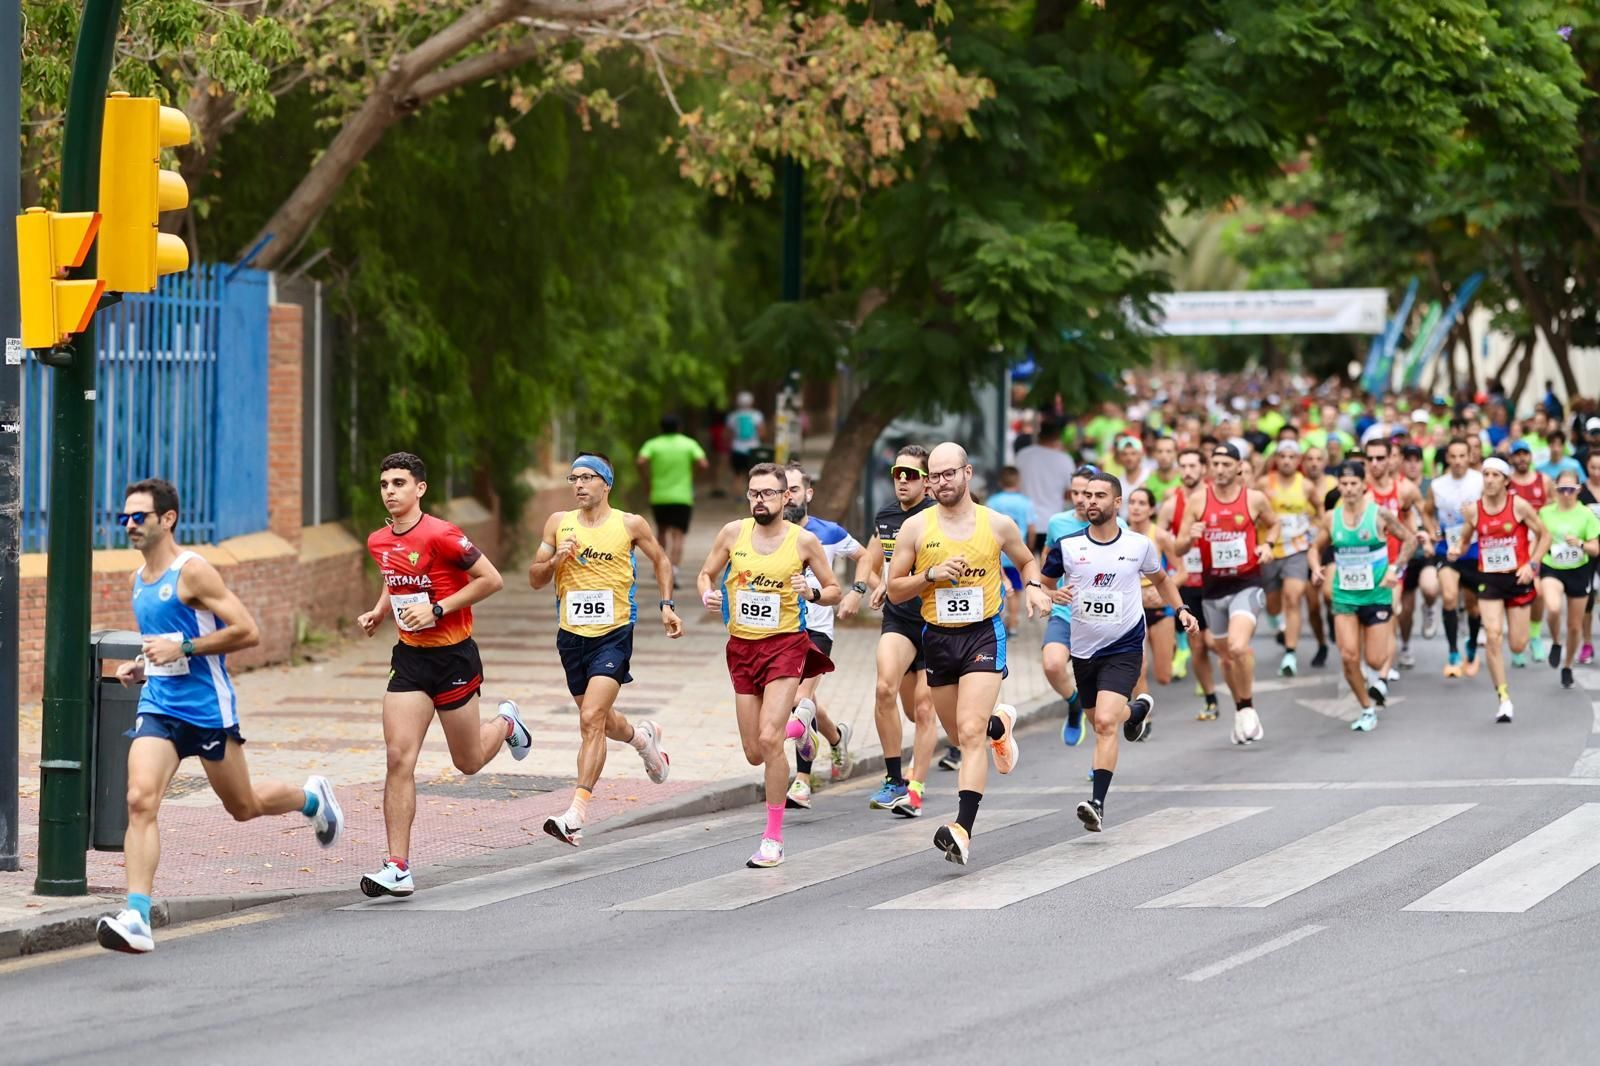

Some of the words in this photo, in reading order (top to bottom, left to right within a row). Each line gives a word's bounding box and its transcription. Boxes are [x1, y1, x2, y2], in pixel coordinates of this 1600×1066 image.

[580, 545, 614, 561] Álora
[1216, 549, 1241, 560] 732
[384, 574, 432, 587] ARTAMA
[752, 573, 784, 588] Álora
[572, 602, 605, 615] 796
[741, 603, 772, 618] 692
[947, 599, 970, 612] 33
[1083, 601, 1115, 614] 790
